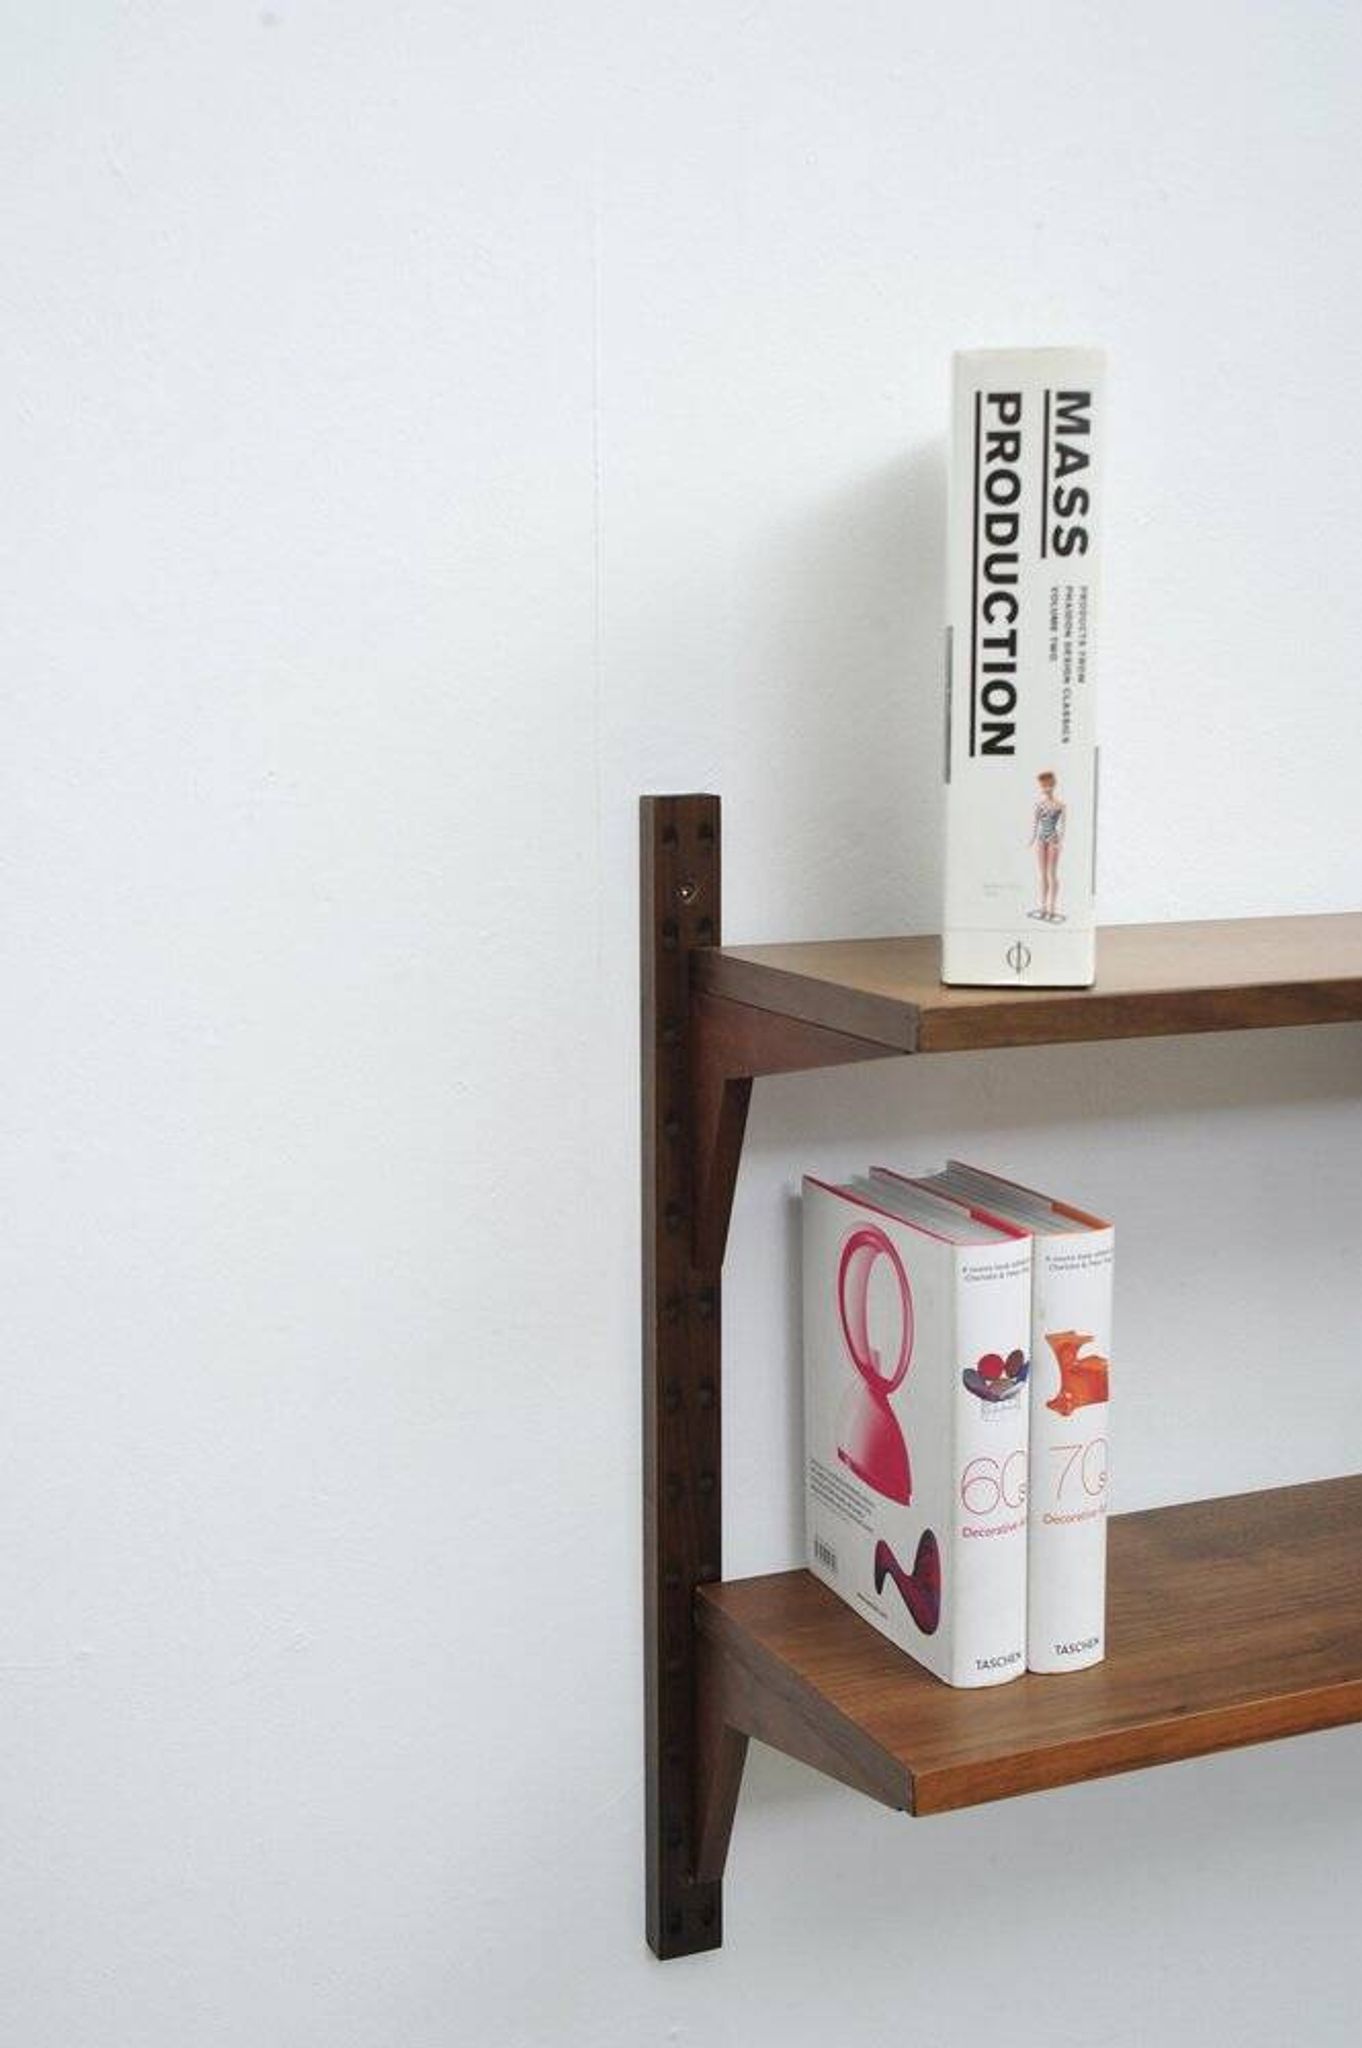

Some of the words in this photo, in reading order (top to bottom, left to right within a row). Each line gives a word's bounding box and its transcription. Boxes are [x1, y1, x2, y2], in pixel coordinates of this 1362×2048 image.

[1052, 391, 1092, 558] MASS
[980, 391, 1023, 757] PRODUCTION
[1049, 586, 1059, 632] VOLUME
[1064, 585, 1073, 638] PHAIDON
[1078, 585, 1088, 647] PRODUCTS
[1049, 636, 1058, 662] TWO
[1063, 641, 1072, 685] DESIGN
[1061, 687, 1071, 745] CLASSICS
[975, 1652, 1022, 1670] TASCHEN
[1054, 1638, 1099, 1656] TASCHEN
